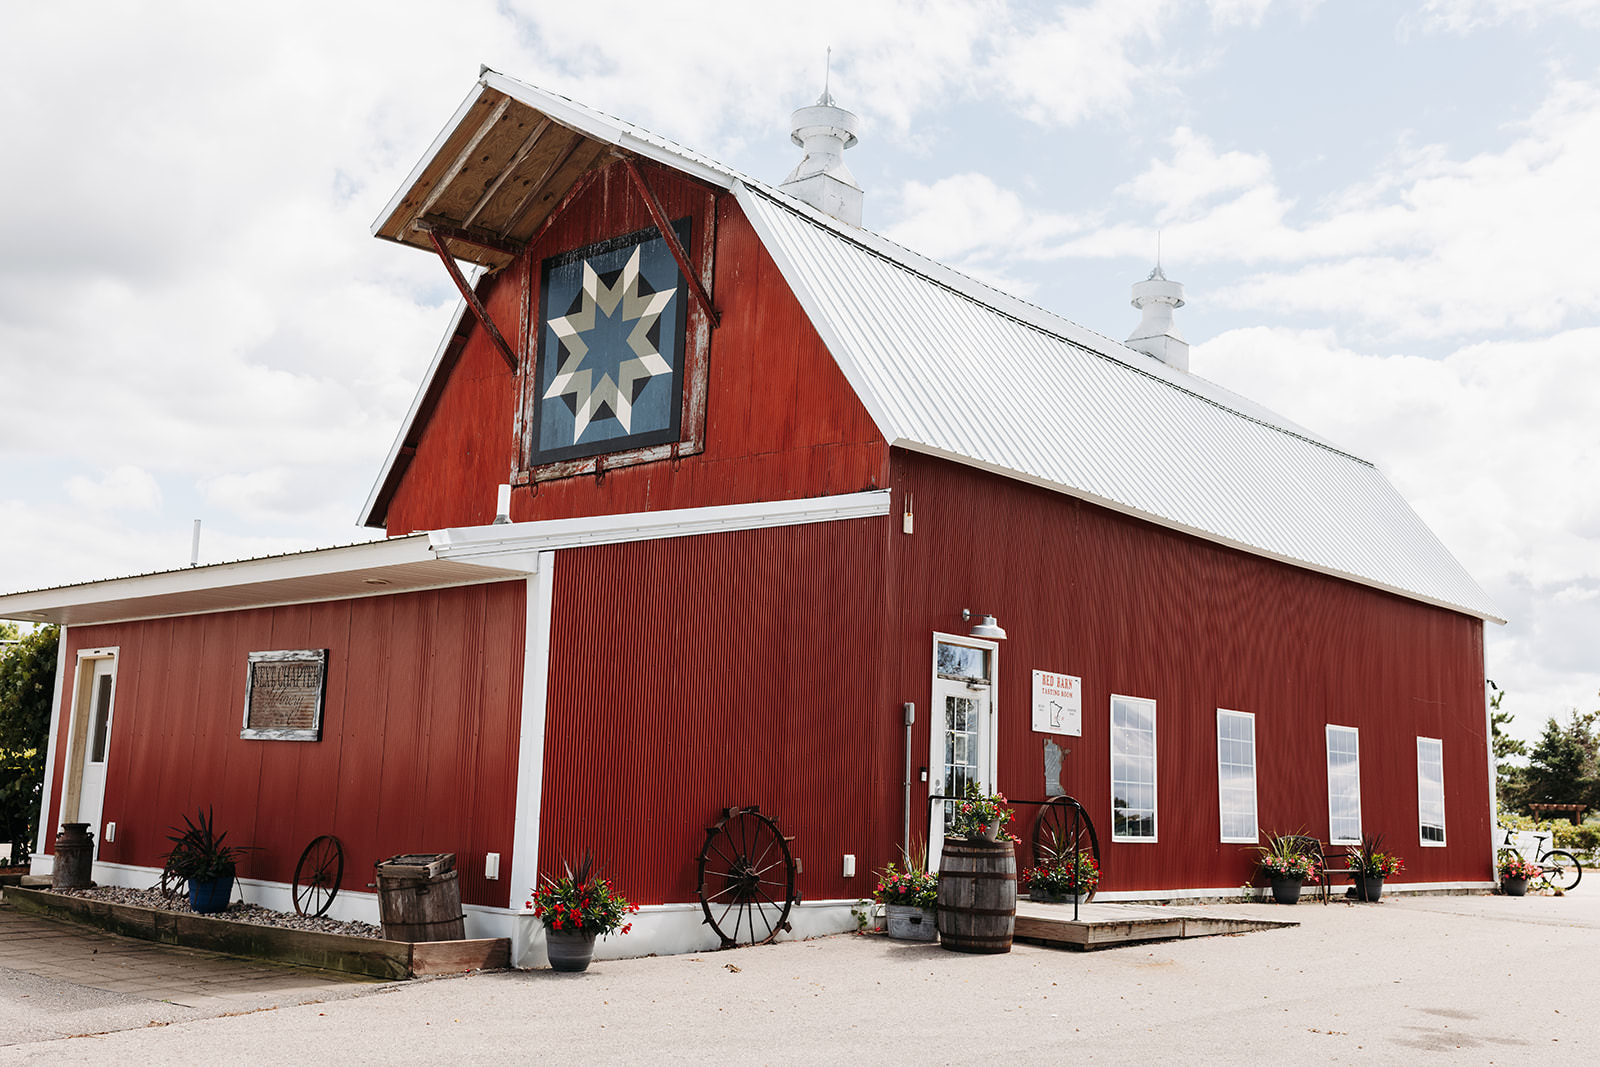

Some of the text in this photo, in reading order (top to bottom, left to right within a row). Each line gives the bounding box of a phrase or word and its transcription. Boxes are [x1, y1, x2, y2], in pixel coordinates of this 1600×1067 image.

[1042, 674, 1073, 690] RED BARN
[1042, 688, 1073, 699] TASTING ROOM
